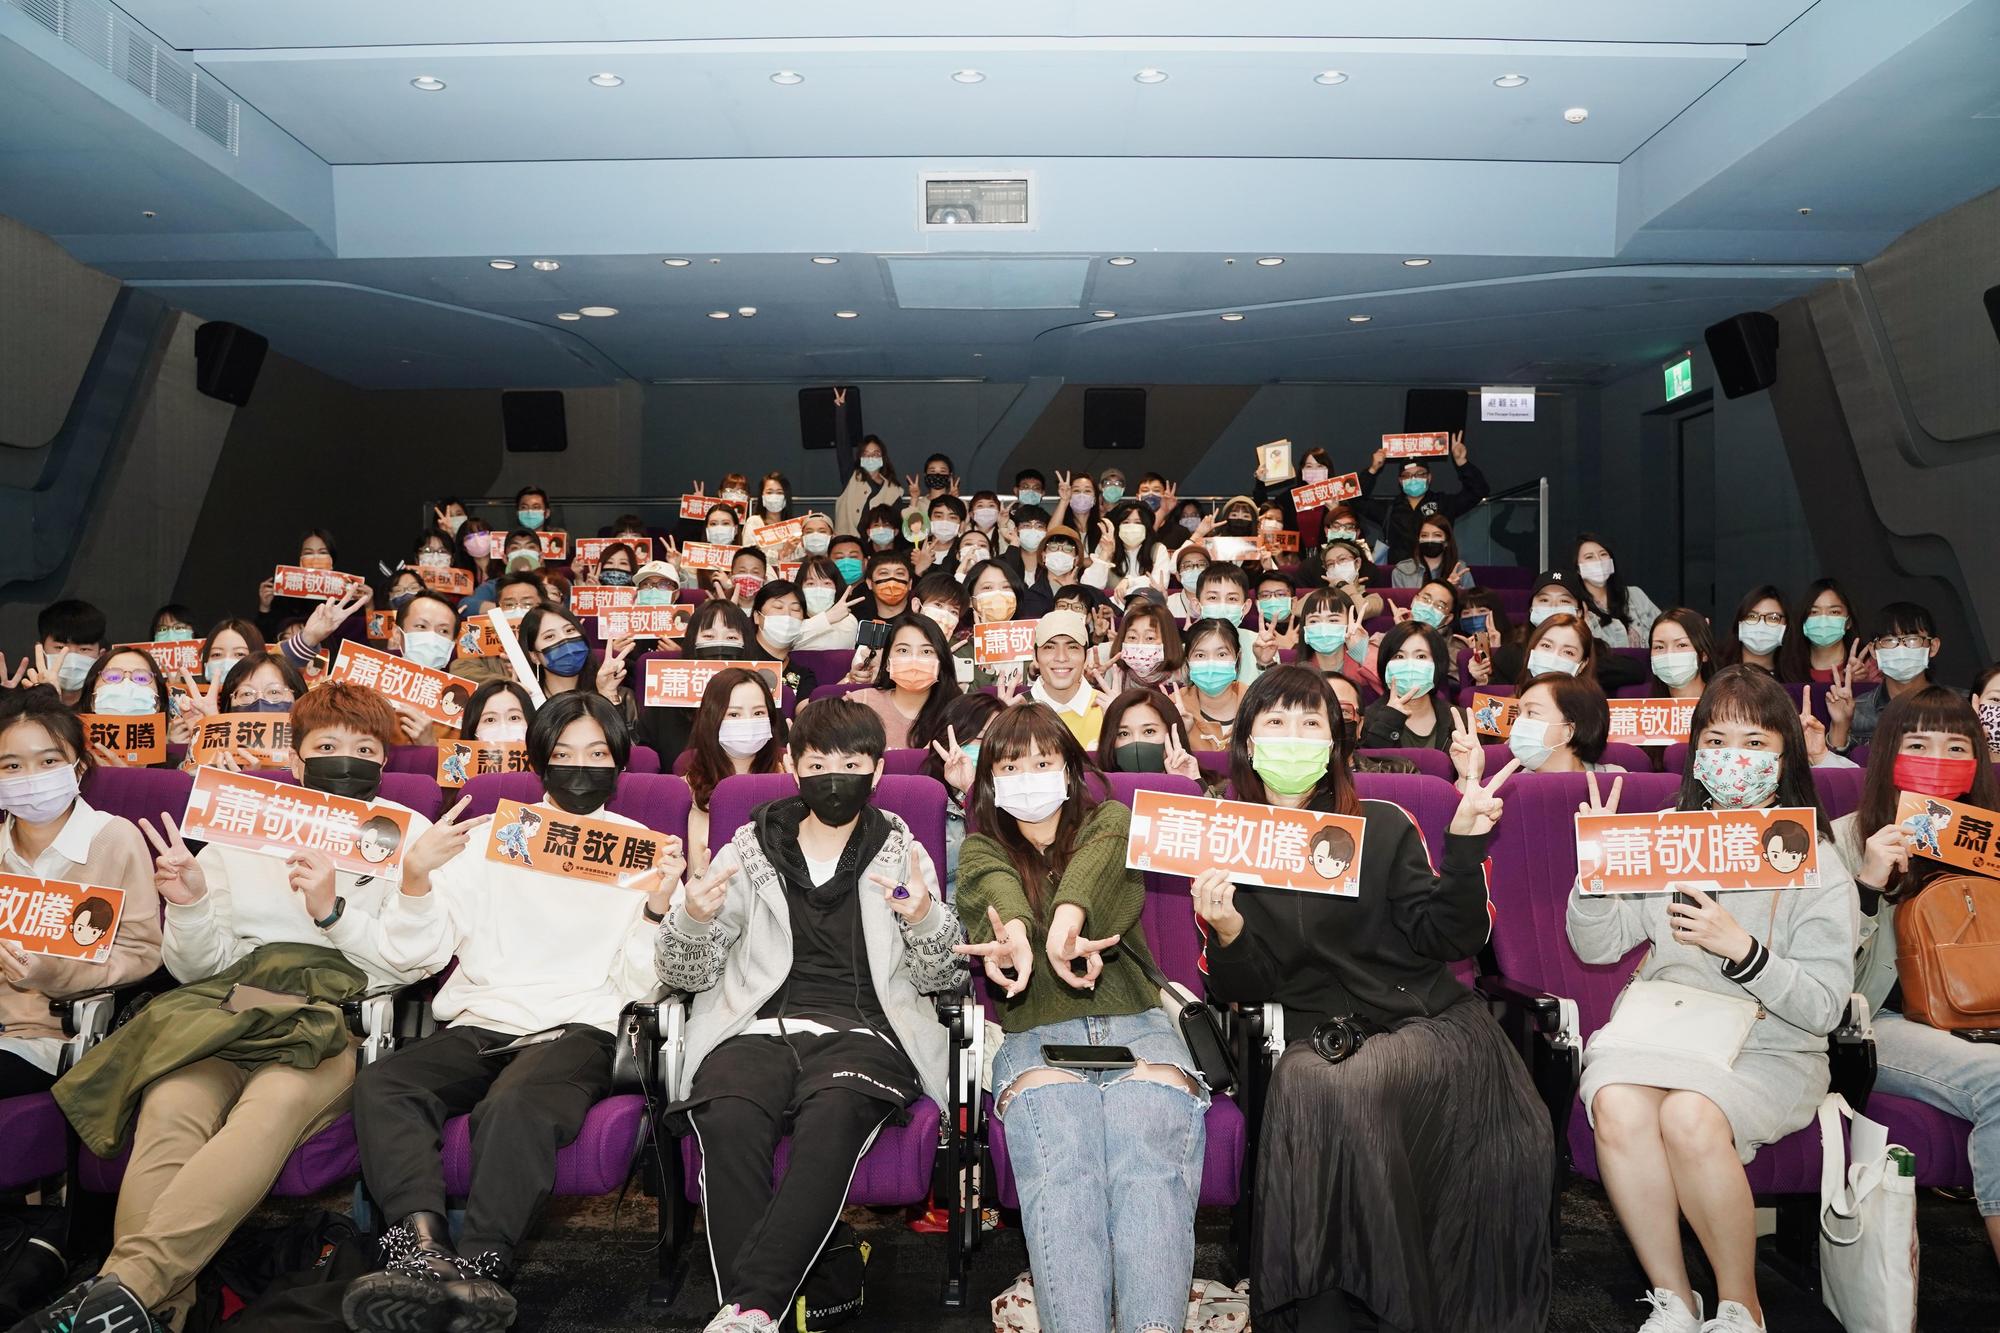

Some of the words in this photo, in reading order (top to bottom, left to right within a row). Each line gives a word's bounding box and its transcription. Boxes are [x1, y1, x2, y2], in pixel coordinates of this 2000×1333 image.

[1390, 437, 1434, 452] 蕭敬騰
[1301, 481, 1345, 505] 蕭敬騰
[284, 572, 345, 595] 蕭敬騰
[608, 611, 672, 632] 蕭敬騰
[347, 652, 442, 709] 蕭敬騰
[1609, 706, 1695, 735] 蕭敬騰
[208, 784, 361, 856] 蕭敬騰
[1154, 807, 1309, 873] 蕭敬騰
[1602, 823, 1761, 876] 蕭敬騰
[829, 1305, 842, 1314] VANS
